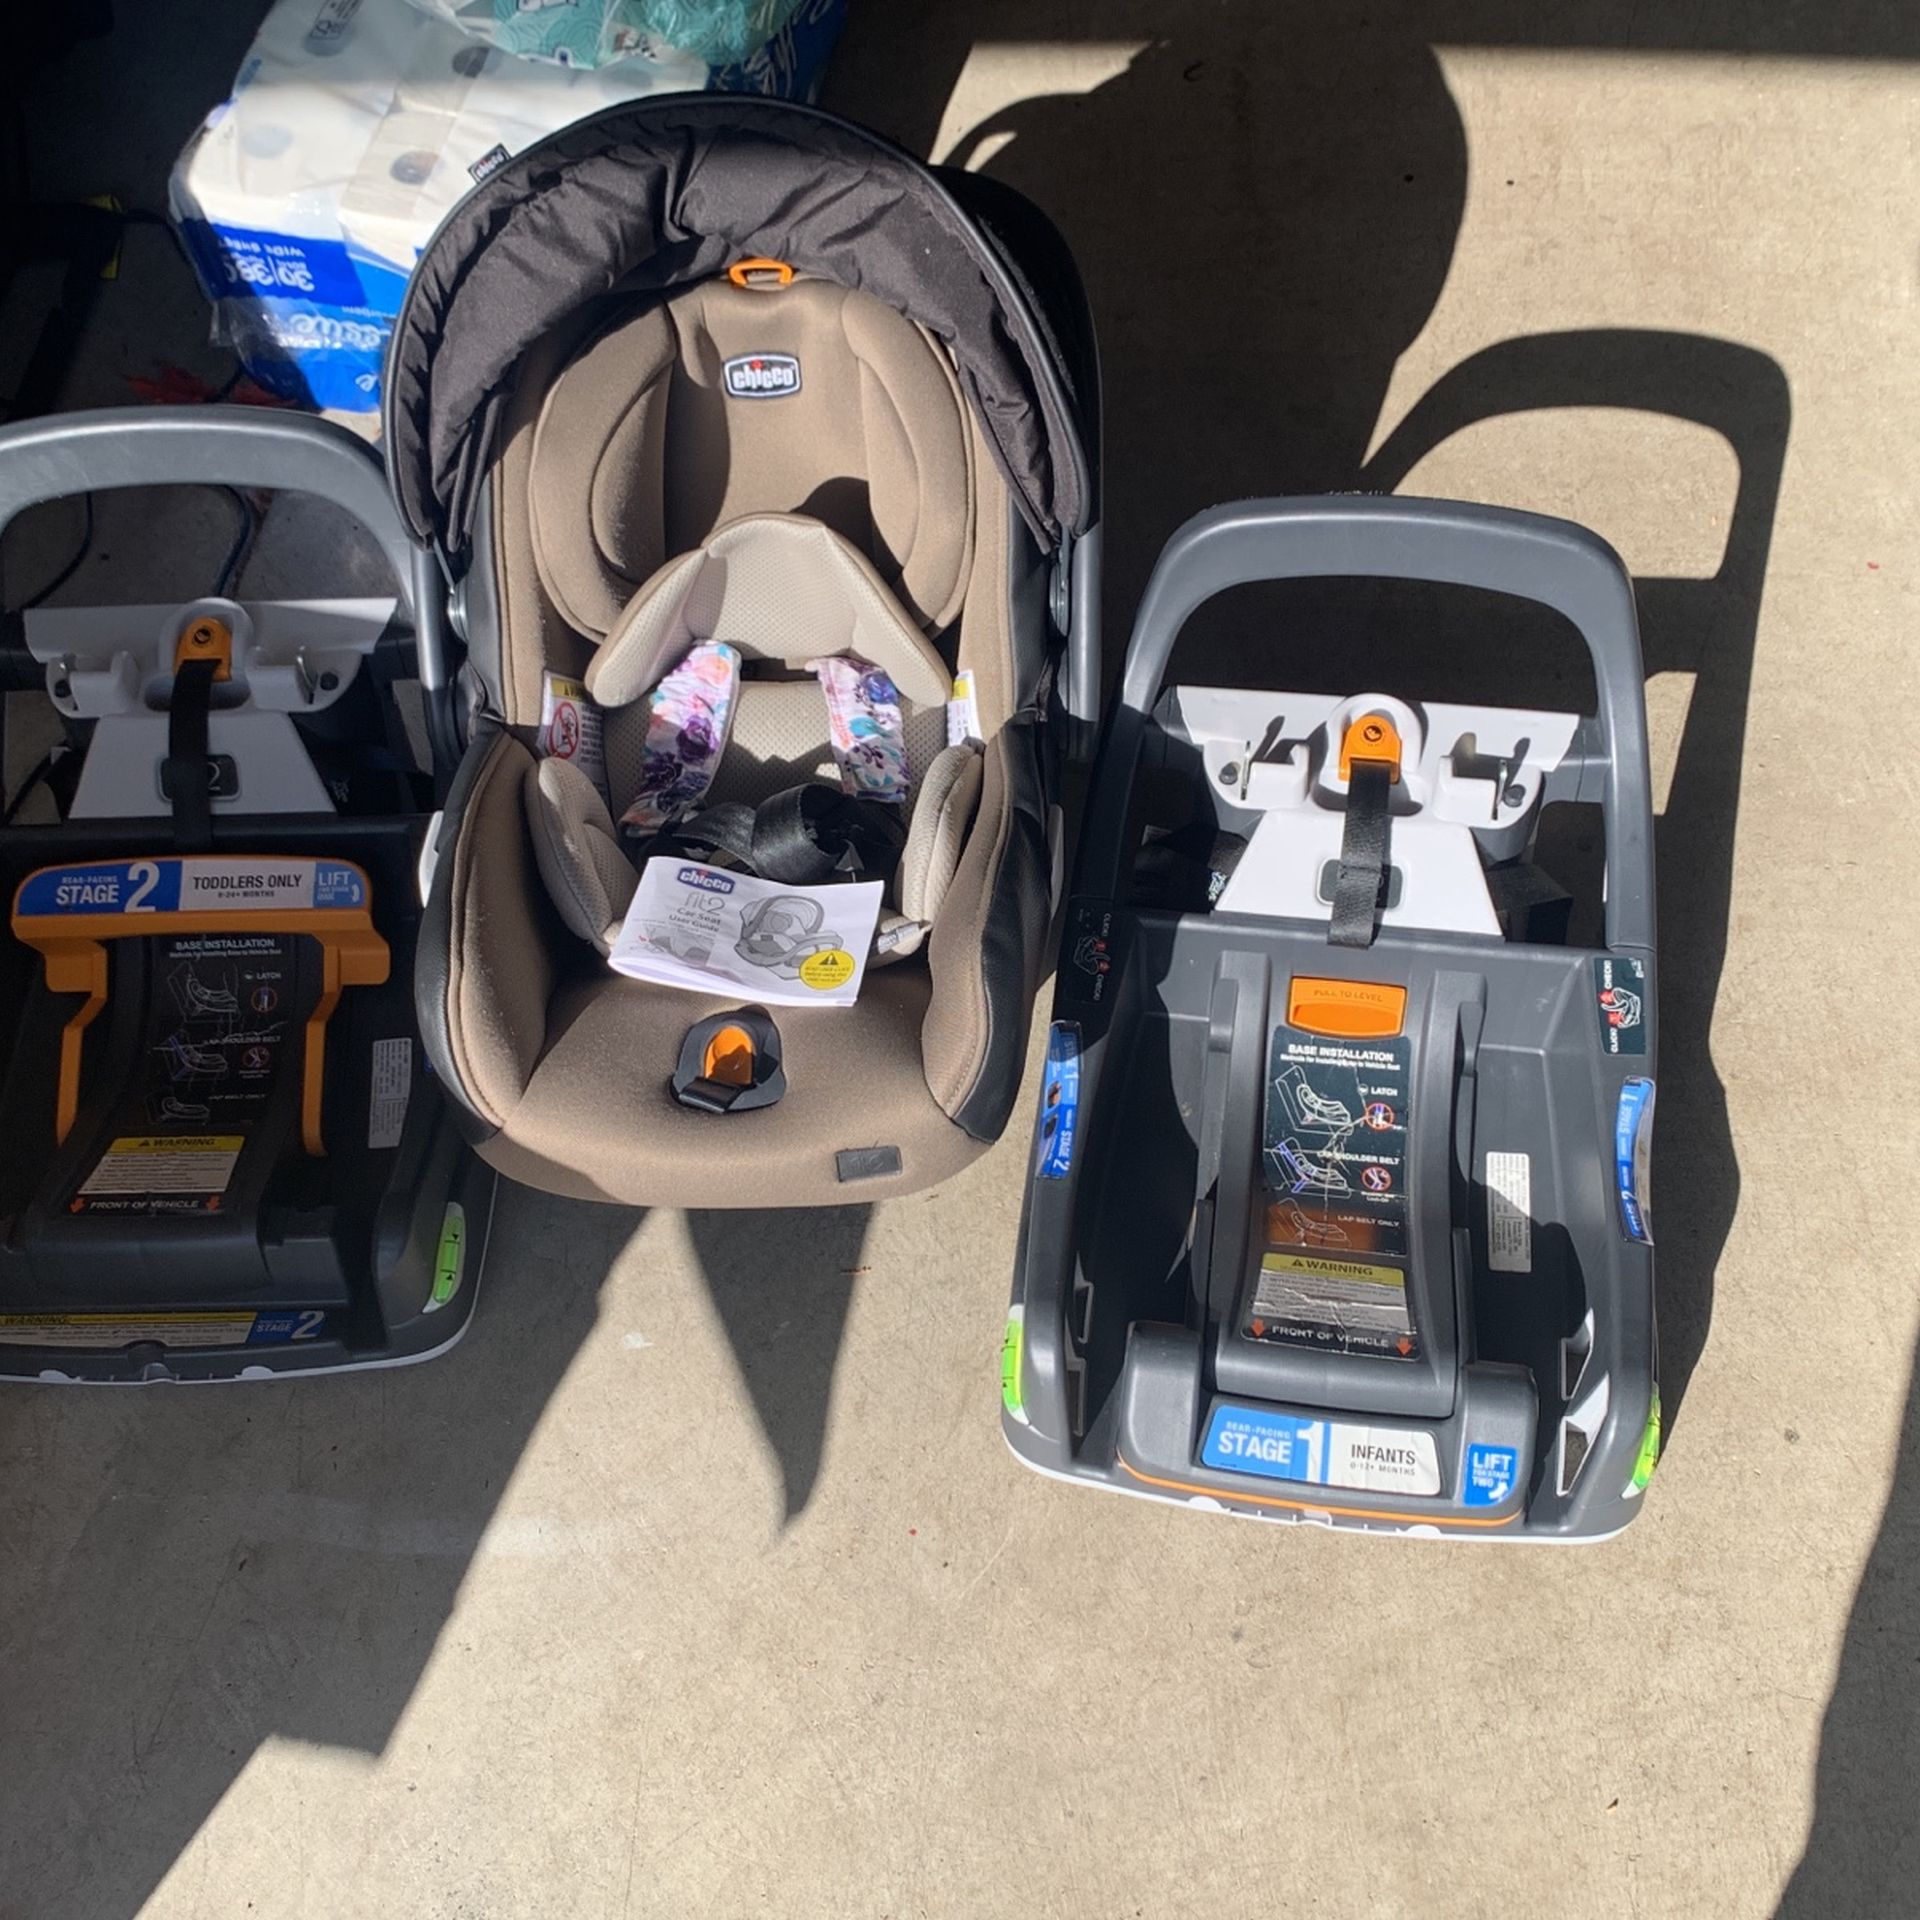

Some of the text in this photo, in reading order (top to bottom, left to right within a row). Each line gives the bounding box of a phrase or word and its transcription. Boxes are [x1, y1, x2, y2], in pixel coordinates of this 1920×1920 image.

[279, 266, 315, 292] 30
[732, 360, 795, 389] chicco
[62, 875, 118, 885] REAR-FACING
[193, 874, 302, 890] TODDLERS ONLY
[318, 871, 351, 886] LIFT
[679, 869, 732, 893] chicco
[56, 861, 160, 913] STAGE 2
[677, 907, 721, 927] Car Seat
[176, 939, 275, 951] BASE INSTALLATION
[256, 972, 281, 980] LATCH
[1314, 989, 1383, 1002] PULL TO LEVEL
[1288, 1044, 1394, 1062] BASE INSTALLATION
[1371, 1086, 1398, 1096] LATCH
[153, 1138, 216, 1147] WARNING
[1059, 1130, 1073, 1158] STAGE
[1053, 1158, 1071, 1172] 2
[1379, 1156, 1400, 1165] BELT
[89, 1200, 200, 1209] FRONT OF VEHICLE
[1356, 1216, 1376, 1224] BELT
[1306, 1260, 1373, 1276] WARNING
[256, 1322, 293, 1333] STAGE
[291, 1310, 325, 1339] 2
[1272, 1325, 1390, 1348] FRONT OF VEHICLE
[1226, 1421, 1291, 1439] REAR-FACING
[1218, 1420, 1324, 1483] STAGE 1
[1351, 1444, 1416, 1465] INFANTS
[1473, 1452, 1513, 1471] LIFT
[1379, 1465, 1416, 1476] MONTHS
[1472, 1476, 1494, 1489] TWO
